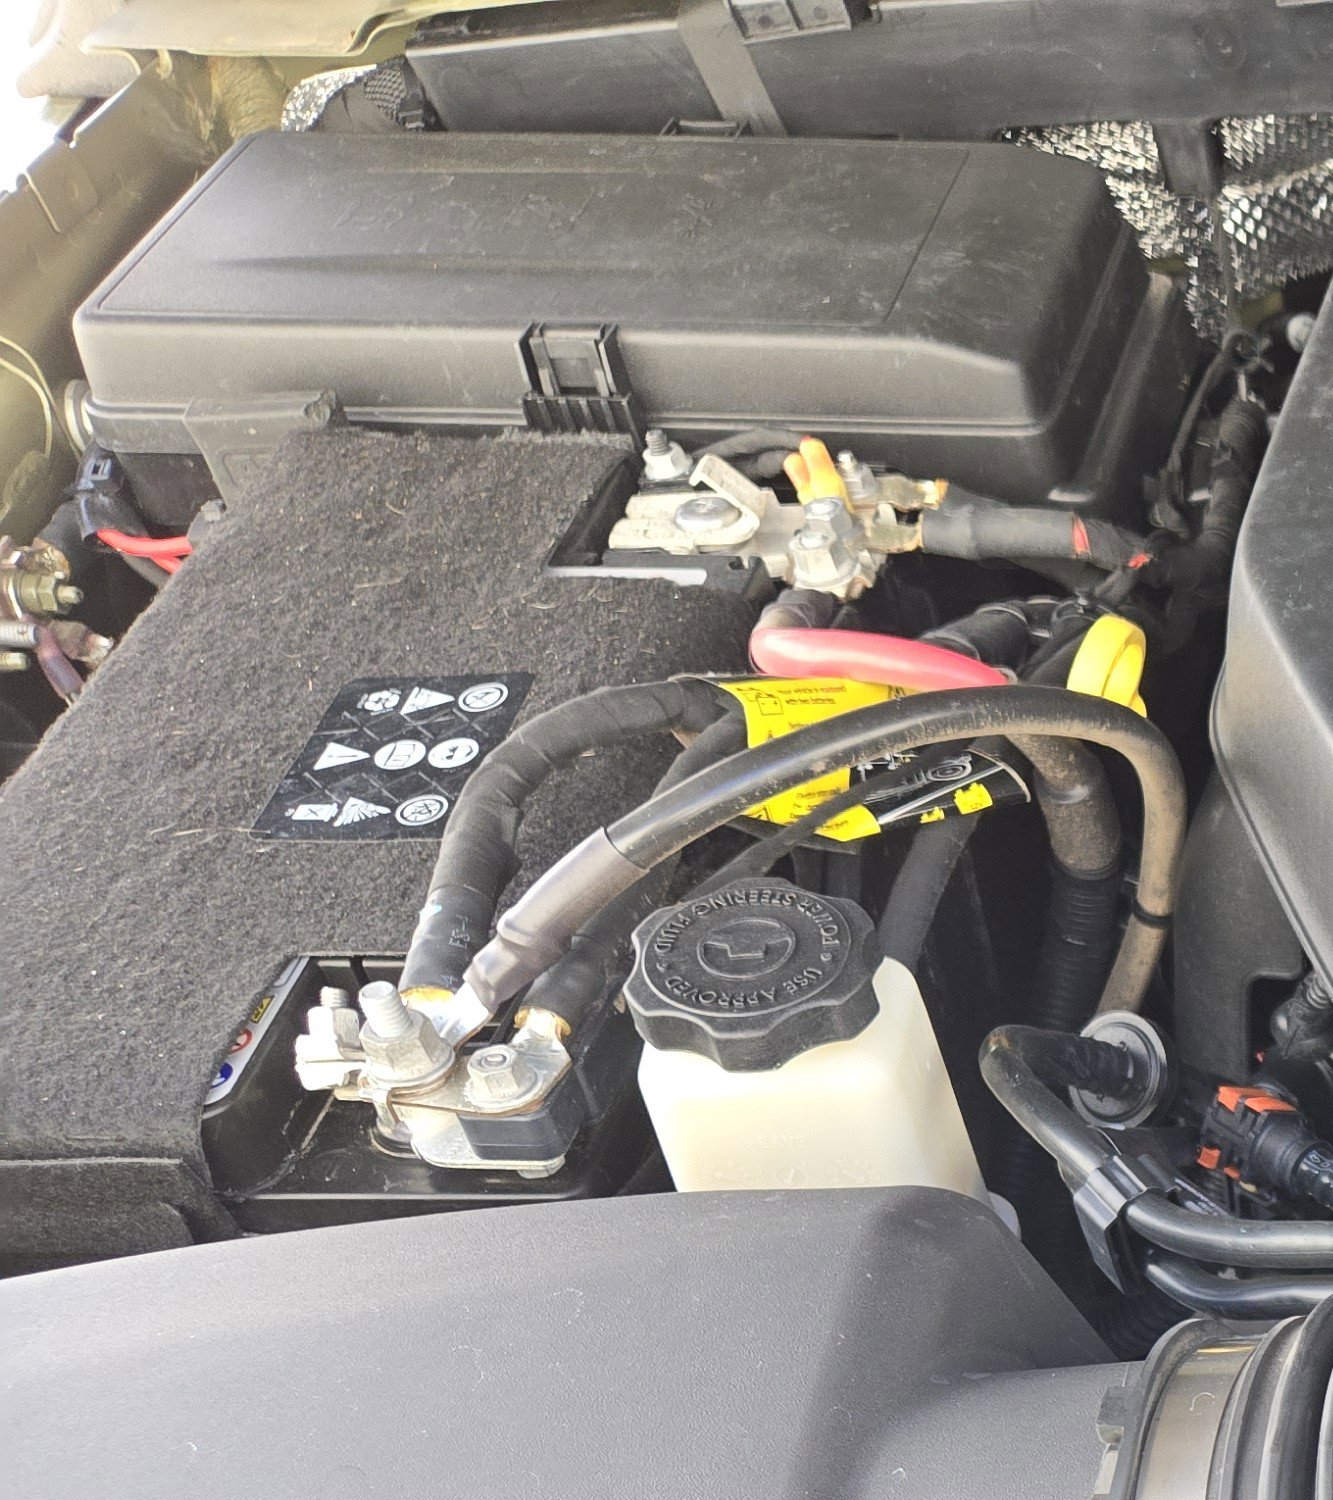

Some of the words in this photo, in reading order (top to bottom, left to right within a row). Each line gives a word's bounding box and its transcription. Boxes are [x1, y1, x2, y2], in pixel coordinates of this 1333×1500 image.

[692, 888, 798, 916] STEERING
[653, 911, 691, 955] FLUID
[664, 974, 777, 1010] APPROVED
[782, 966, 824, 994] USE
